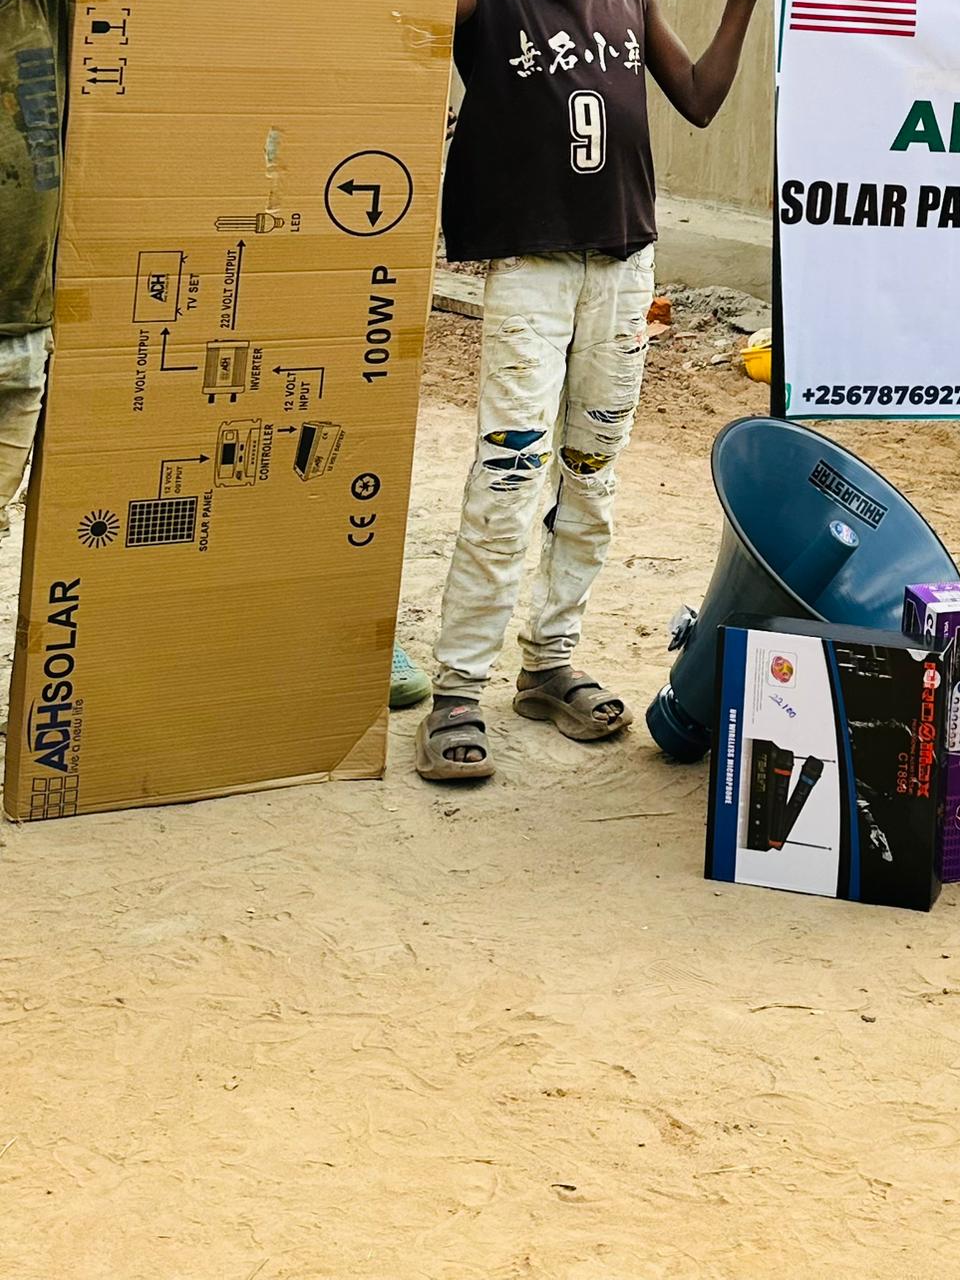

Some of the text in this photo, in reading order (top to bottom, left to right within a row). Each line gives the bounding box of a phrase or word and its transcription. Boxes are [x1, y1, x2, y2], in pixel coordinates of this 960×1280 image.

[568, 90, 606, 174] 9
[290, 213, 301, 232] LED
[780, 180, 907, 228] SOLAR
[187, 273, 200, 310] TV SET
[220, 250, 237, 329] 220 VOLT OUTPUT
[362, 266, 396, 383] 100W P
[133, 329, 149, 412] 220 VOLT OUTPUT
[250, 348, 263, 391] INVERTER
[284, 371, 296, 411] 12 VOLT
[299, 381, 311, 411] INPUT
[259, 424, 274, 481] CONTROLLER
[174, 466, 183, 494] OUTPUT
[810, 464, 885, 525] AHUJASTAR
[199, 489, 214, 552] SOLAR PANEL
[68, 698, 84, 774] live a new life
[724, 758, 735, 805] MICROPHONE
